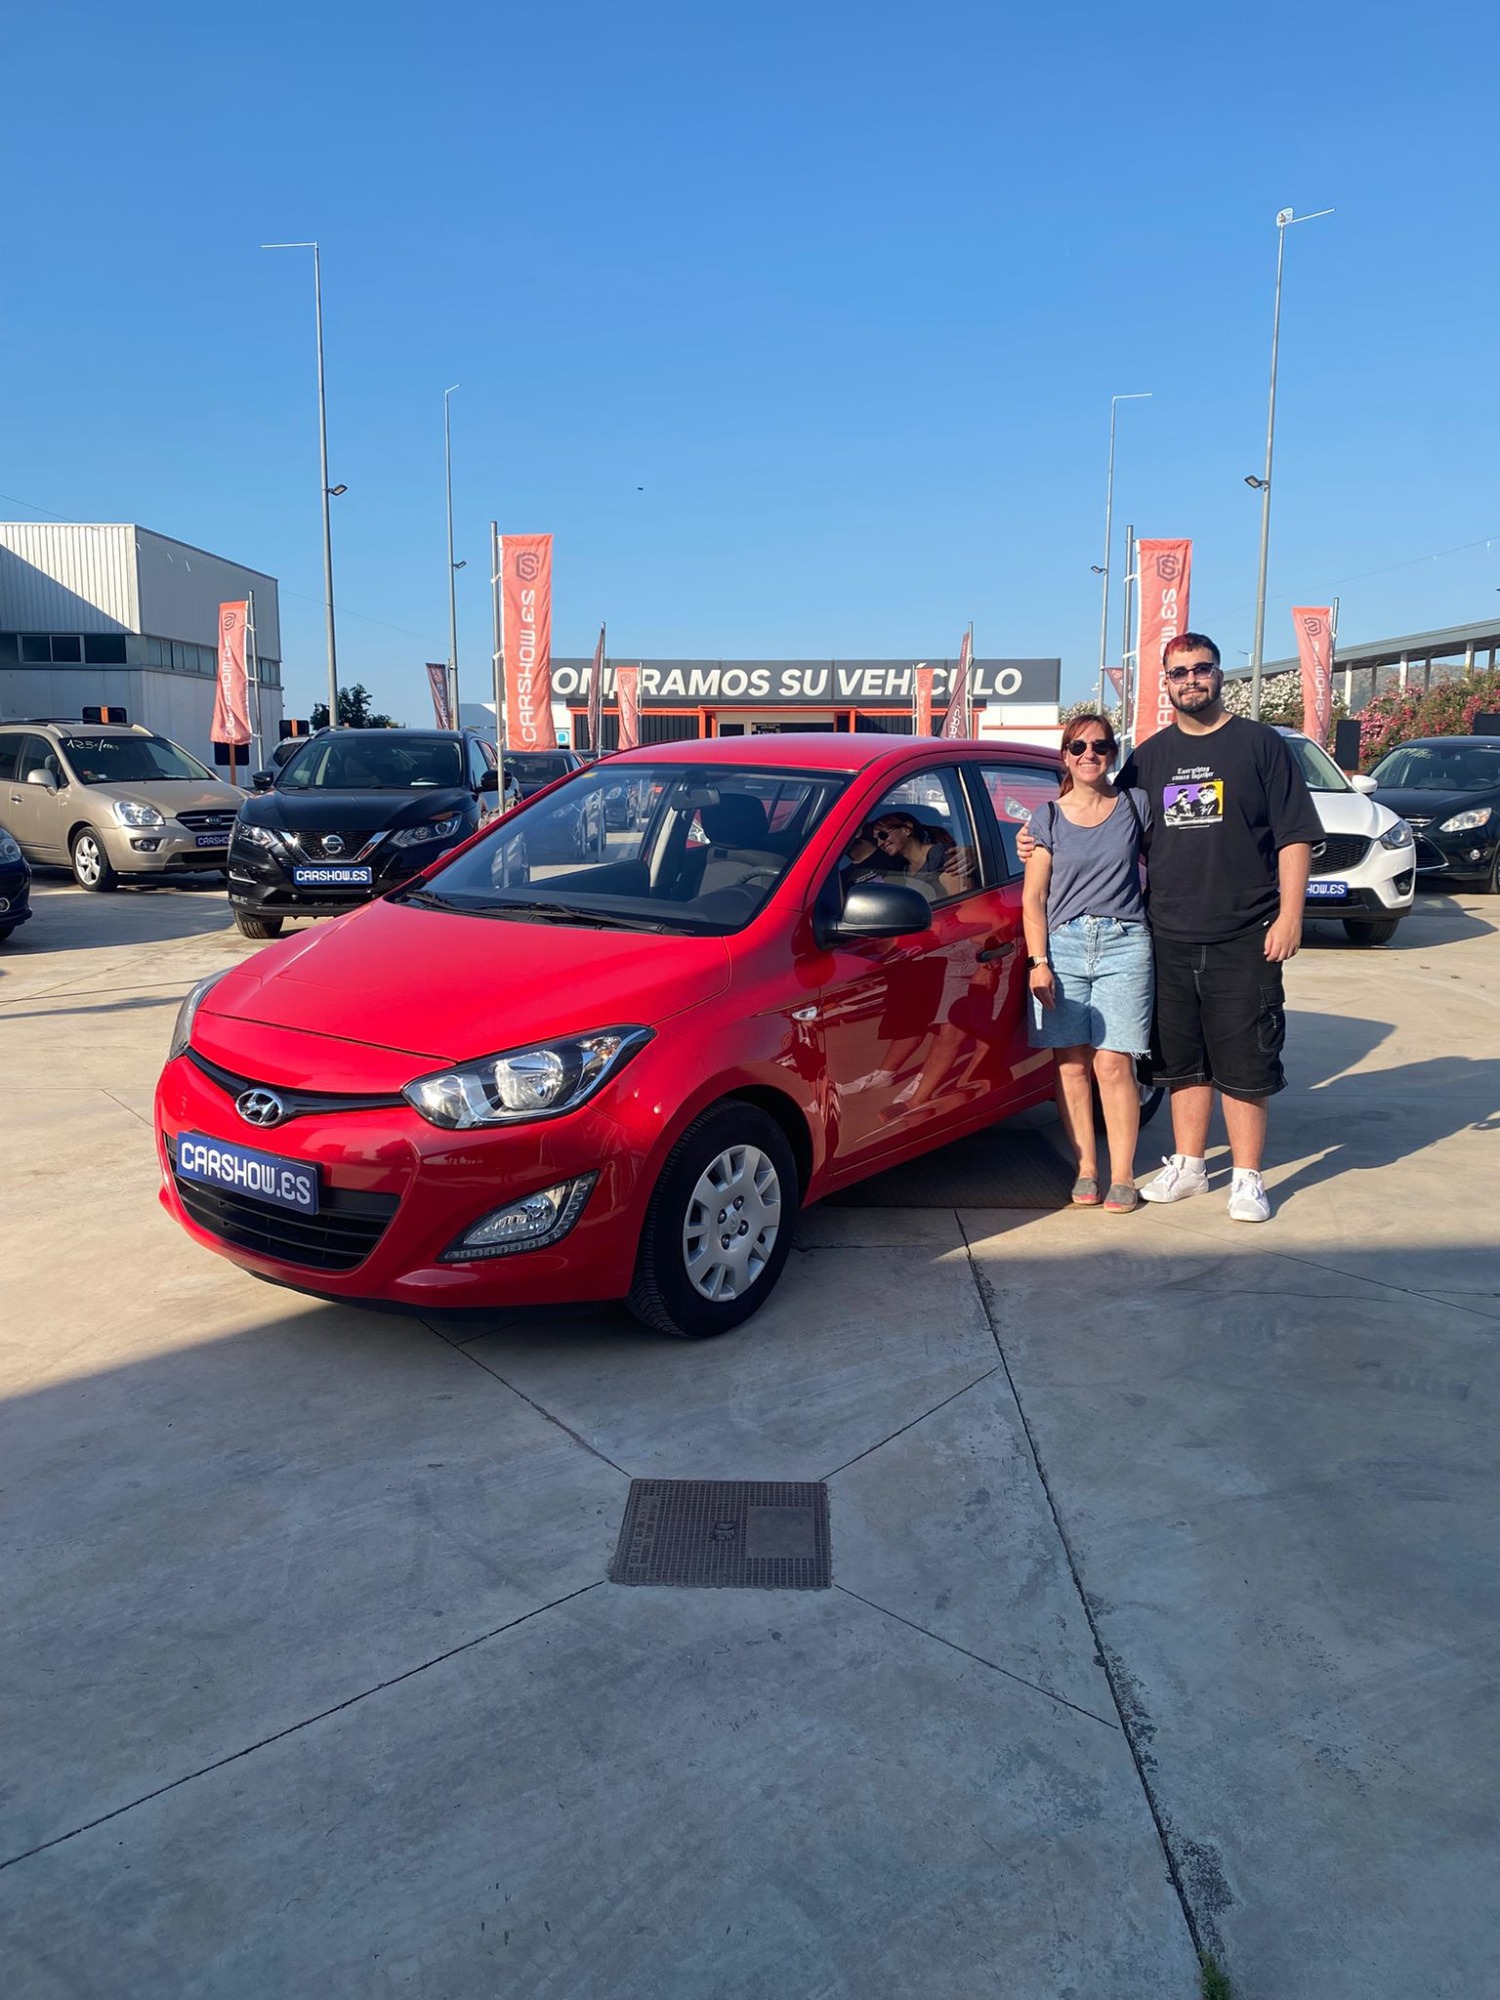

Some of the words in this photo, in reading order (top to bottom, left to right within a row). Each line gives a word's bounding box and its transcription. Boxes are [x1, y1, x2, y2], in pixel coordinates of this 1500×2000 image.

[517, 589, 537, 742] CARSHOW.ES
[550, 667, 771, 697] OMRAMOS
[779, 668, 828, 697] SU
[296, 870, 368, 881] CARSHOW.ES
[1306, 884, 1345, 894] HOW.ES
[181, 1142, 311, 1205] CARSHOW.ES
